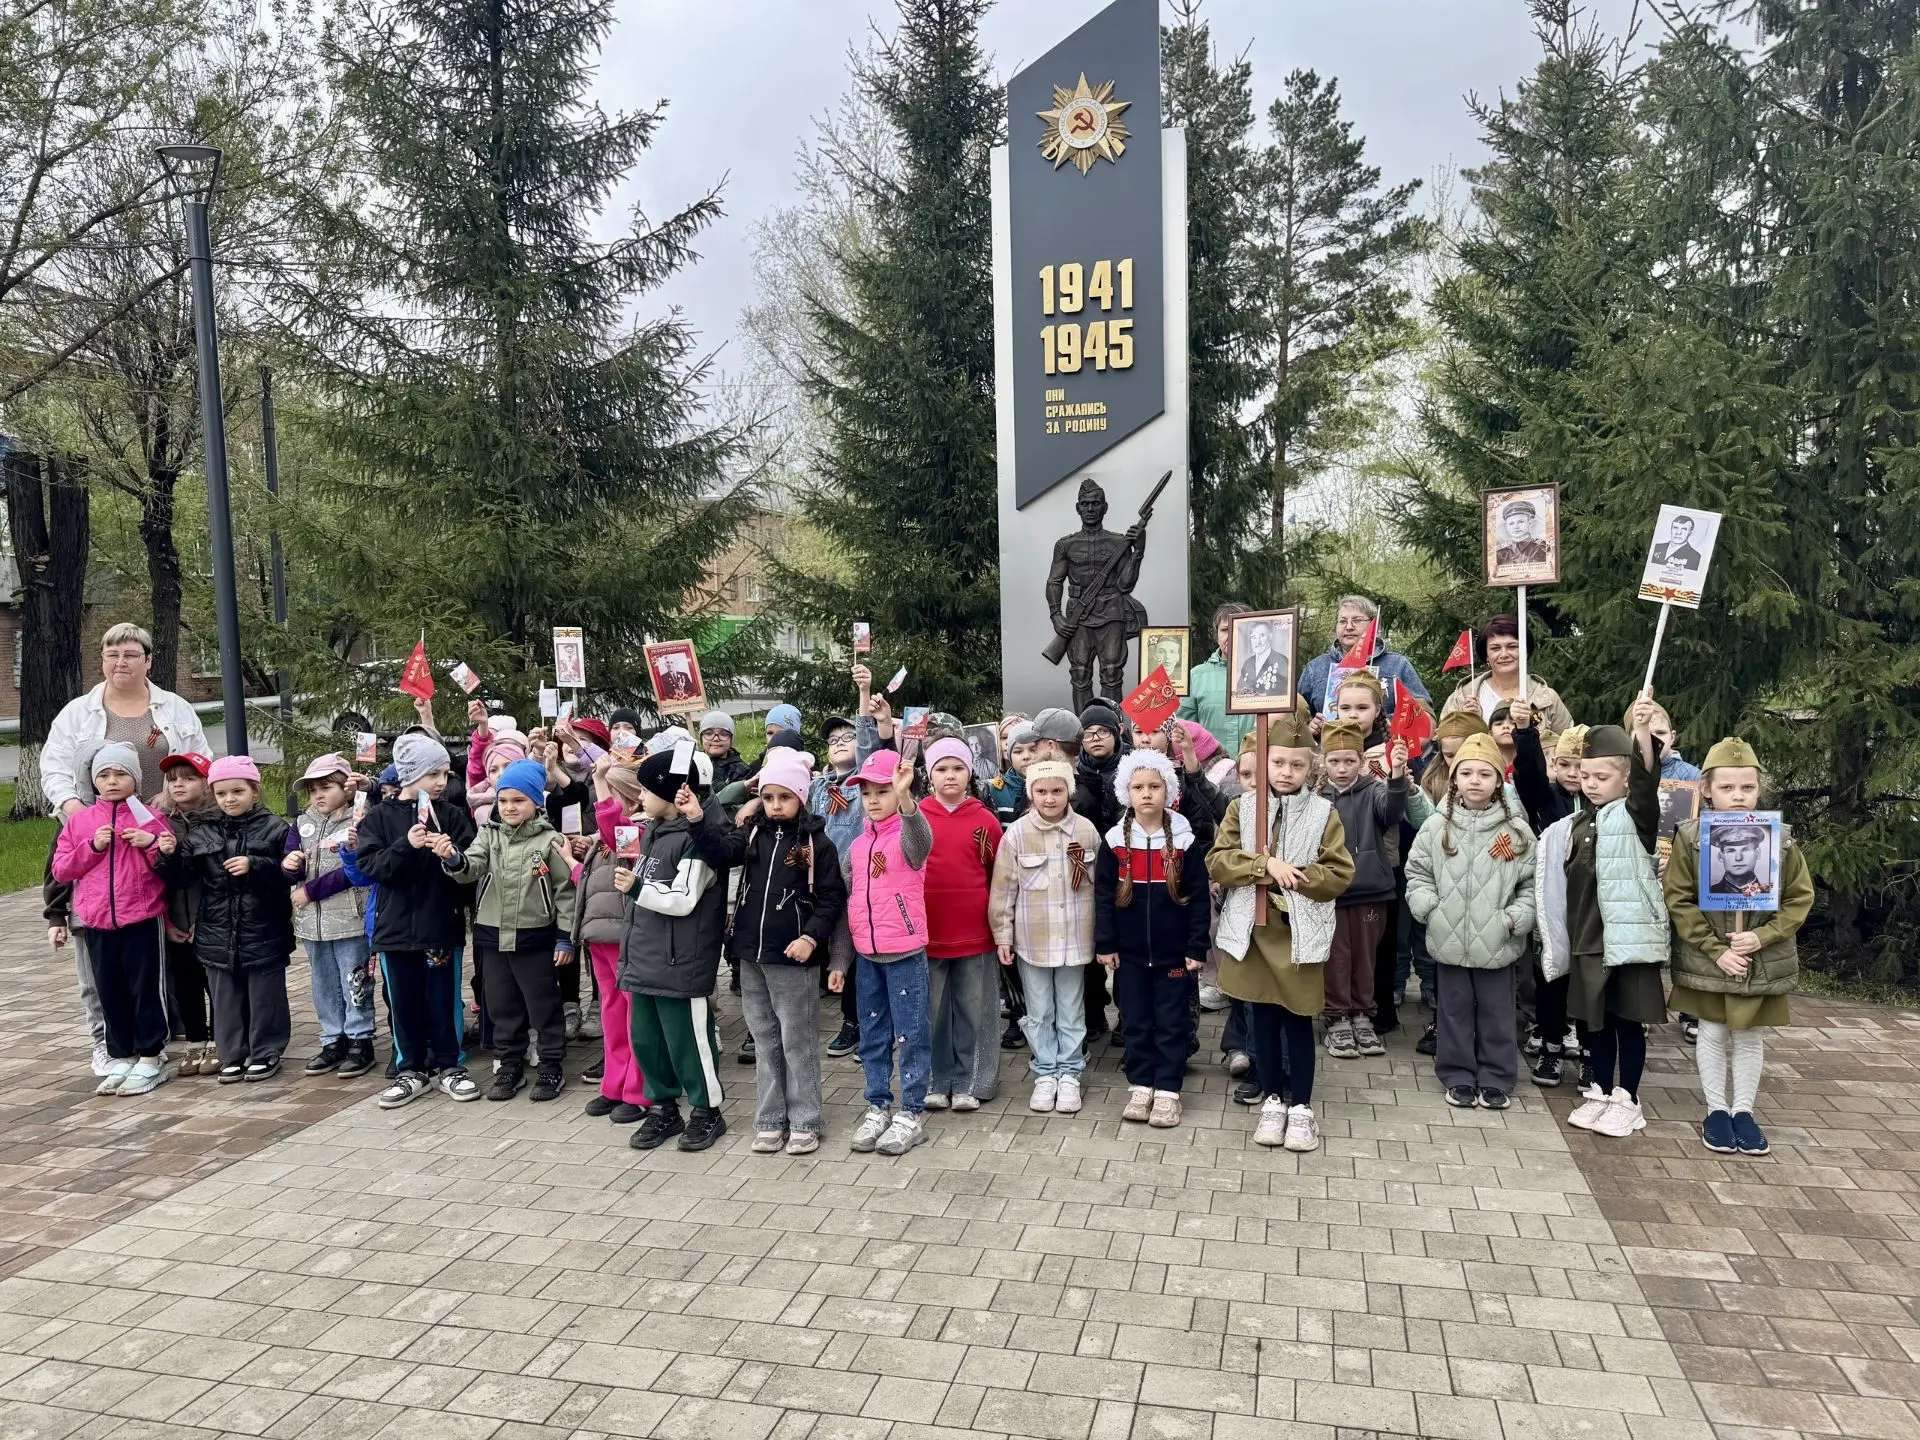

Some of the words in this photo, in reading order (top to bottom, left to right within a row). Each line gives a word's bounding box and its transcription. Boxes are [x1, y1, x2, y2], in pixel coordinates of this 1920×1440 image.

[1039, 258, 1133, 315] 1941
[1040, 319, 1134, 374] 1945
[1045, 388, 1065, 402] ОНИ
[1045, 402, 1107, 418] СРАЖАЛИСЬ
[1046, 421, 1060, 434] ЗА
[1065, 418, 1107, 433] РОДИНУ
